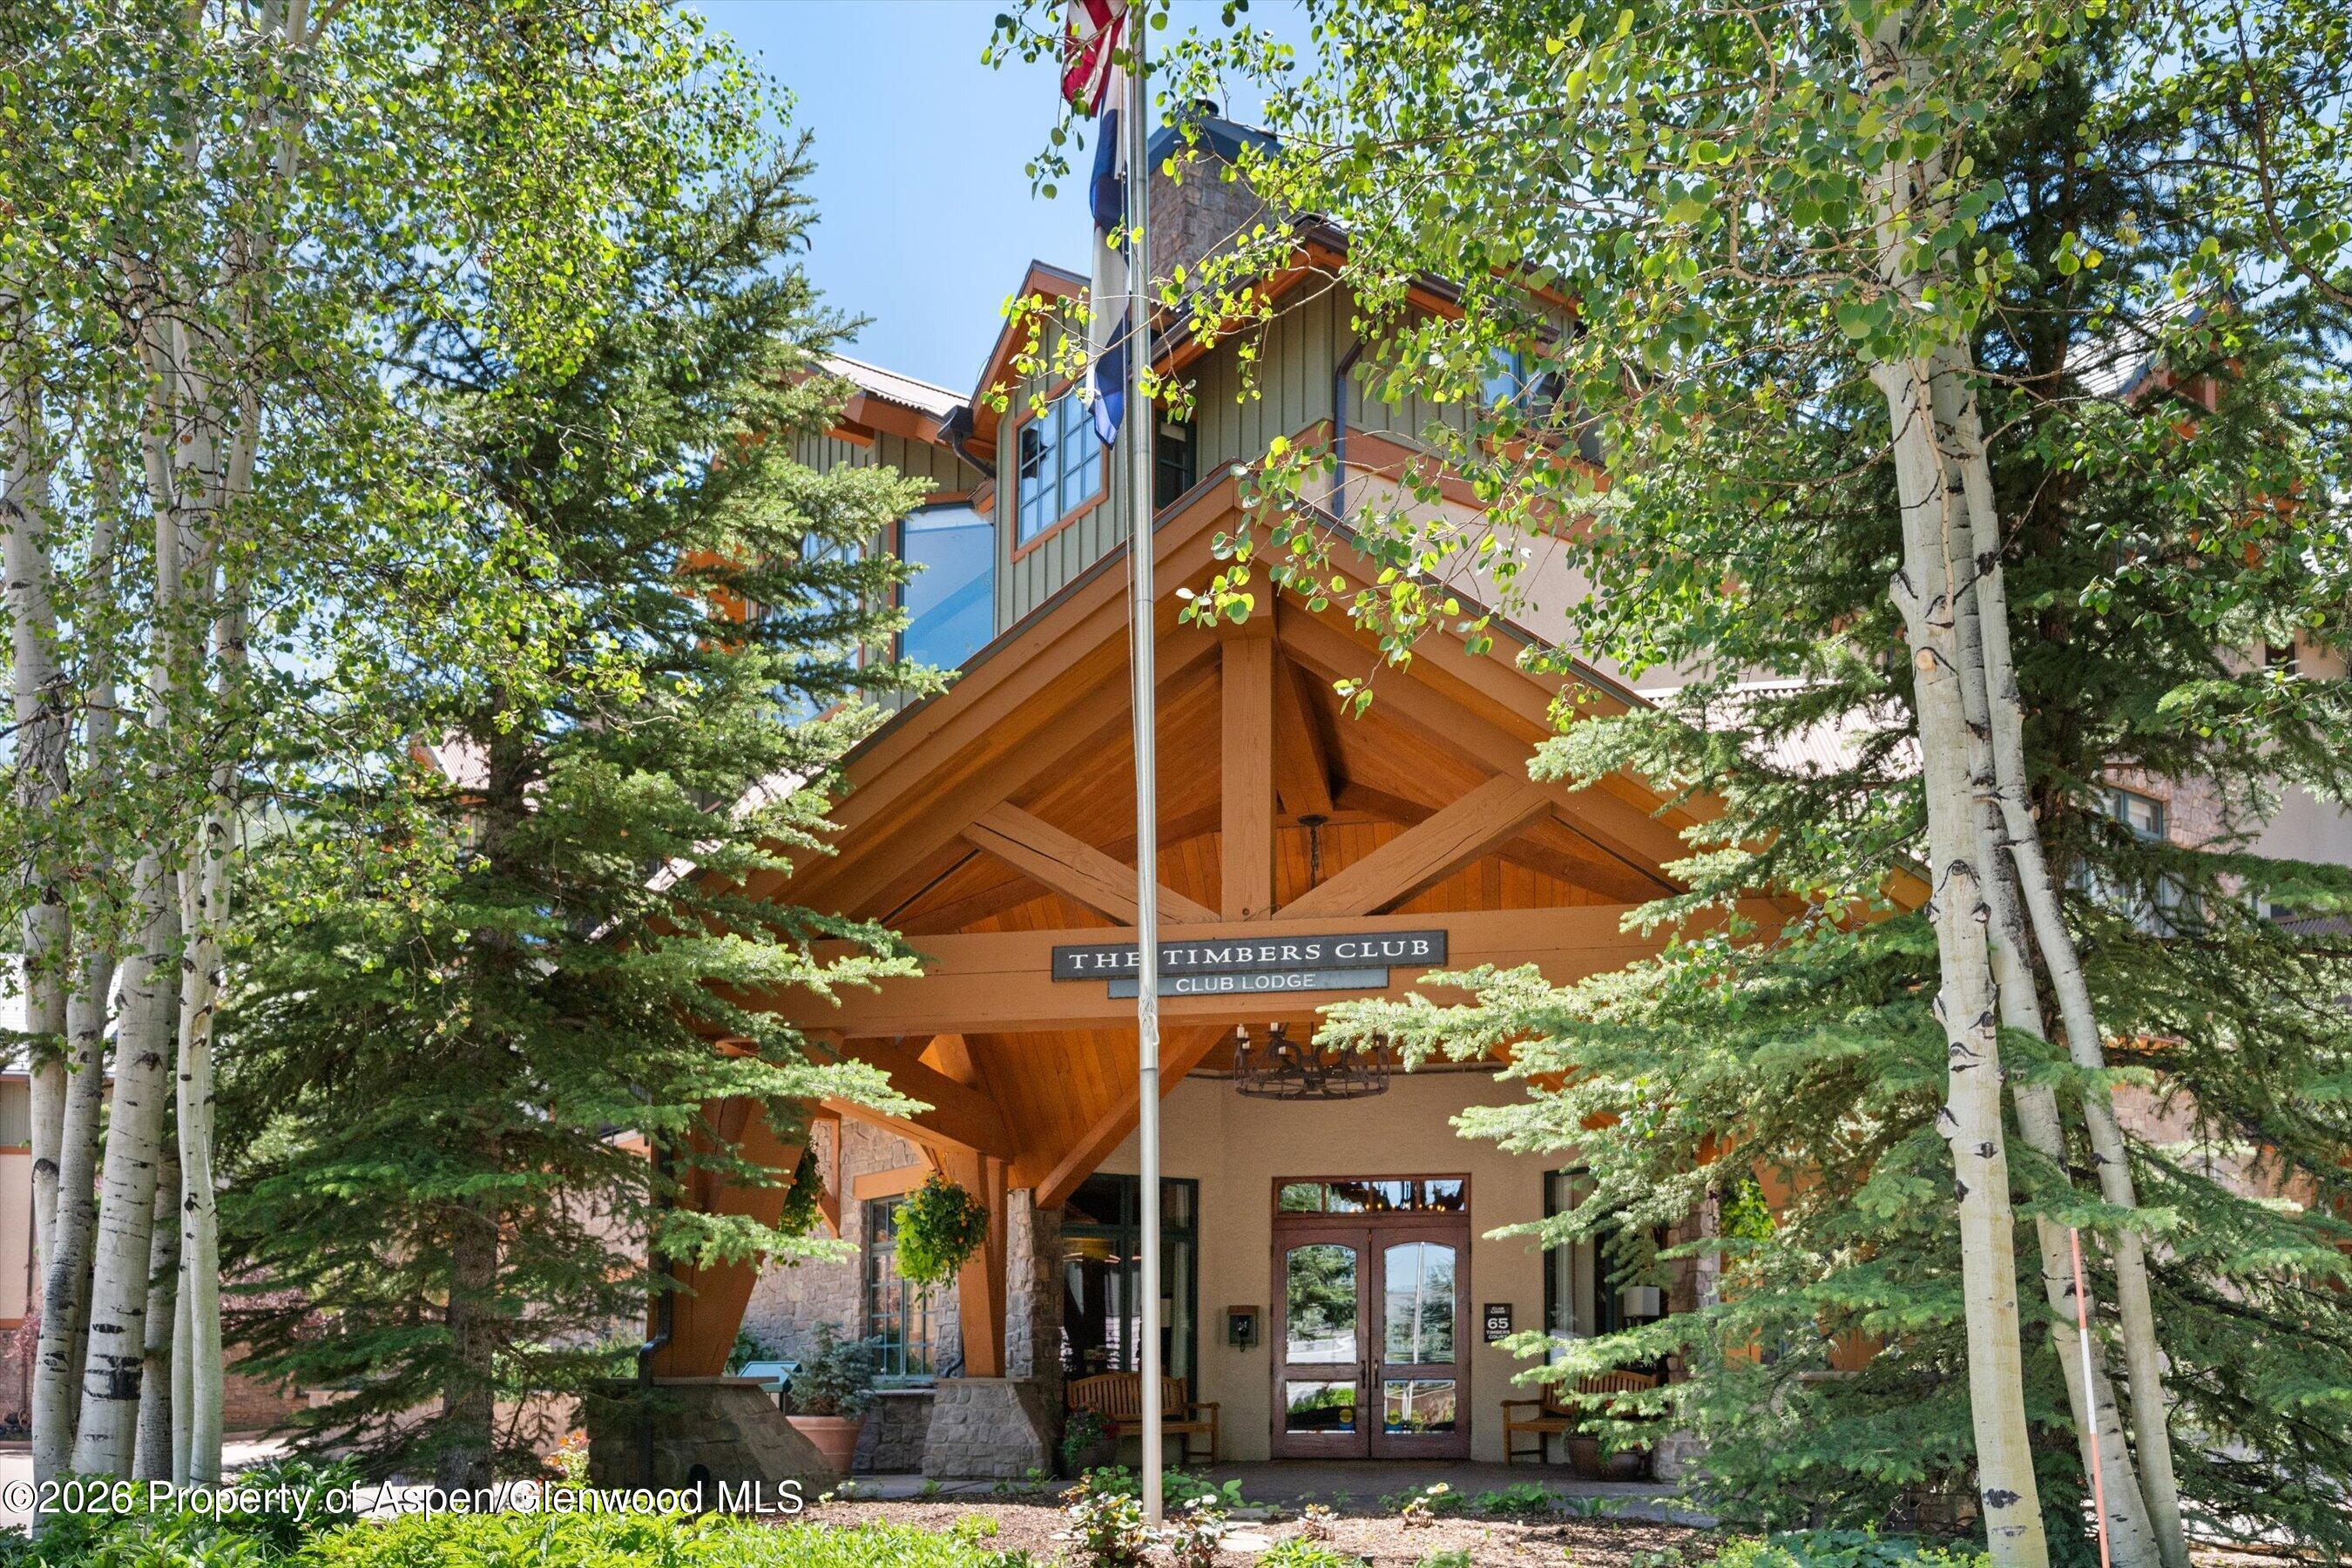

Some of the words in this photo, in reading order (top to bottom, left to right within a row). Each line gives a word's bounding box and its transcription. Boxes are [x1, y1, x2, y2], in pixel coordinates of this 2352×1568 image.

[1068, 951, 1139, 970] THE
[1163, 943, 1321, 965] TIMBERS
[1335, 940, 1430, 958] CLUB
[1175, 977, 1234, 992] CLUB
[1241, 973, 1316, 990] LODGE
[1487, 1318, 1509, 1329] 65
